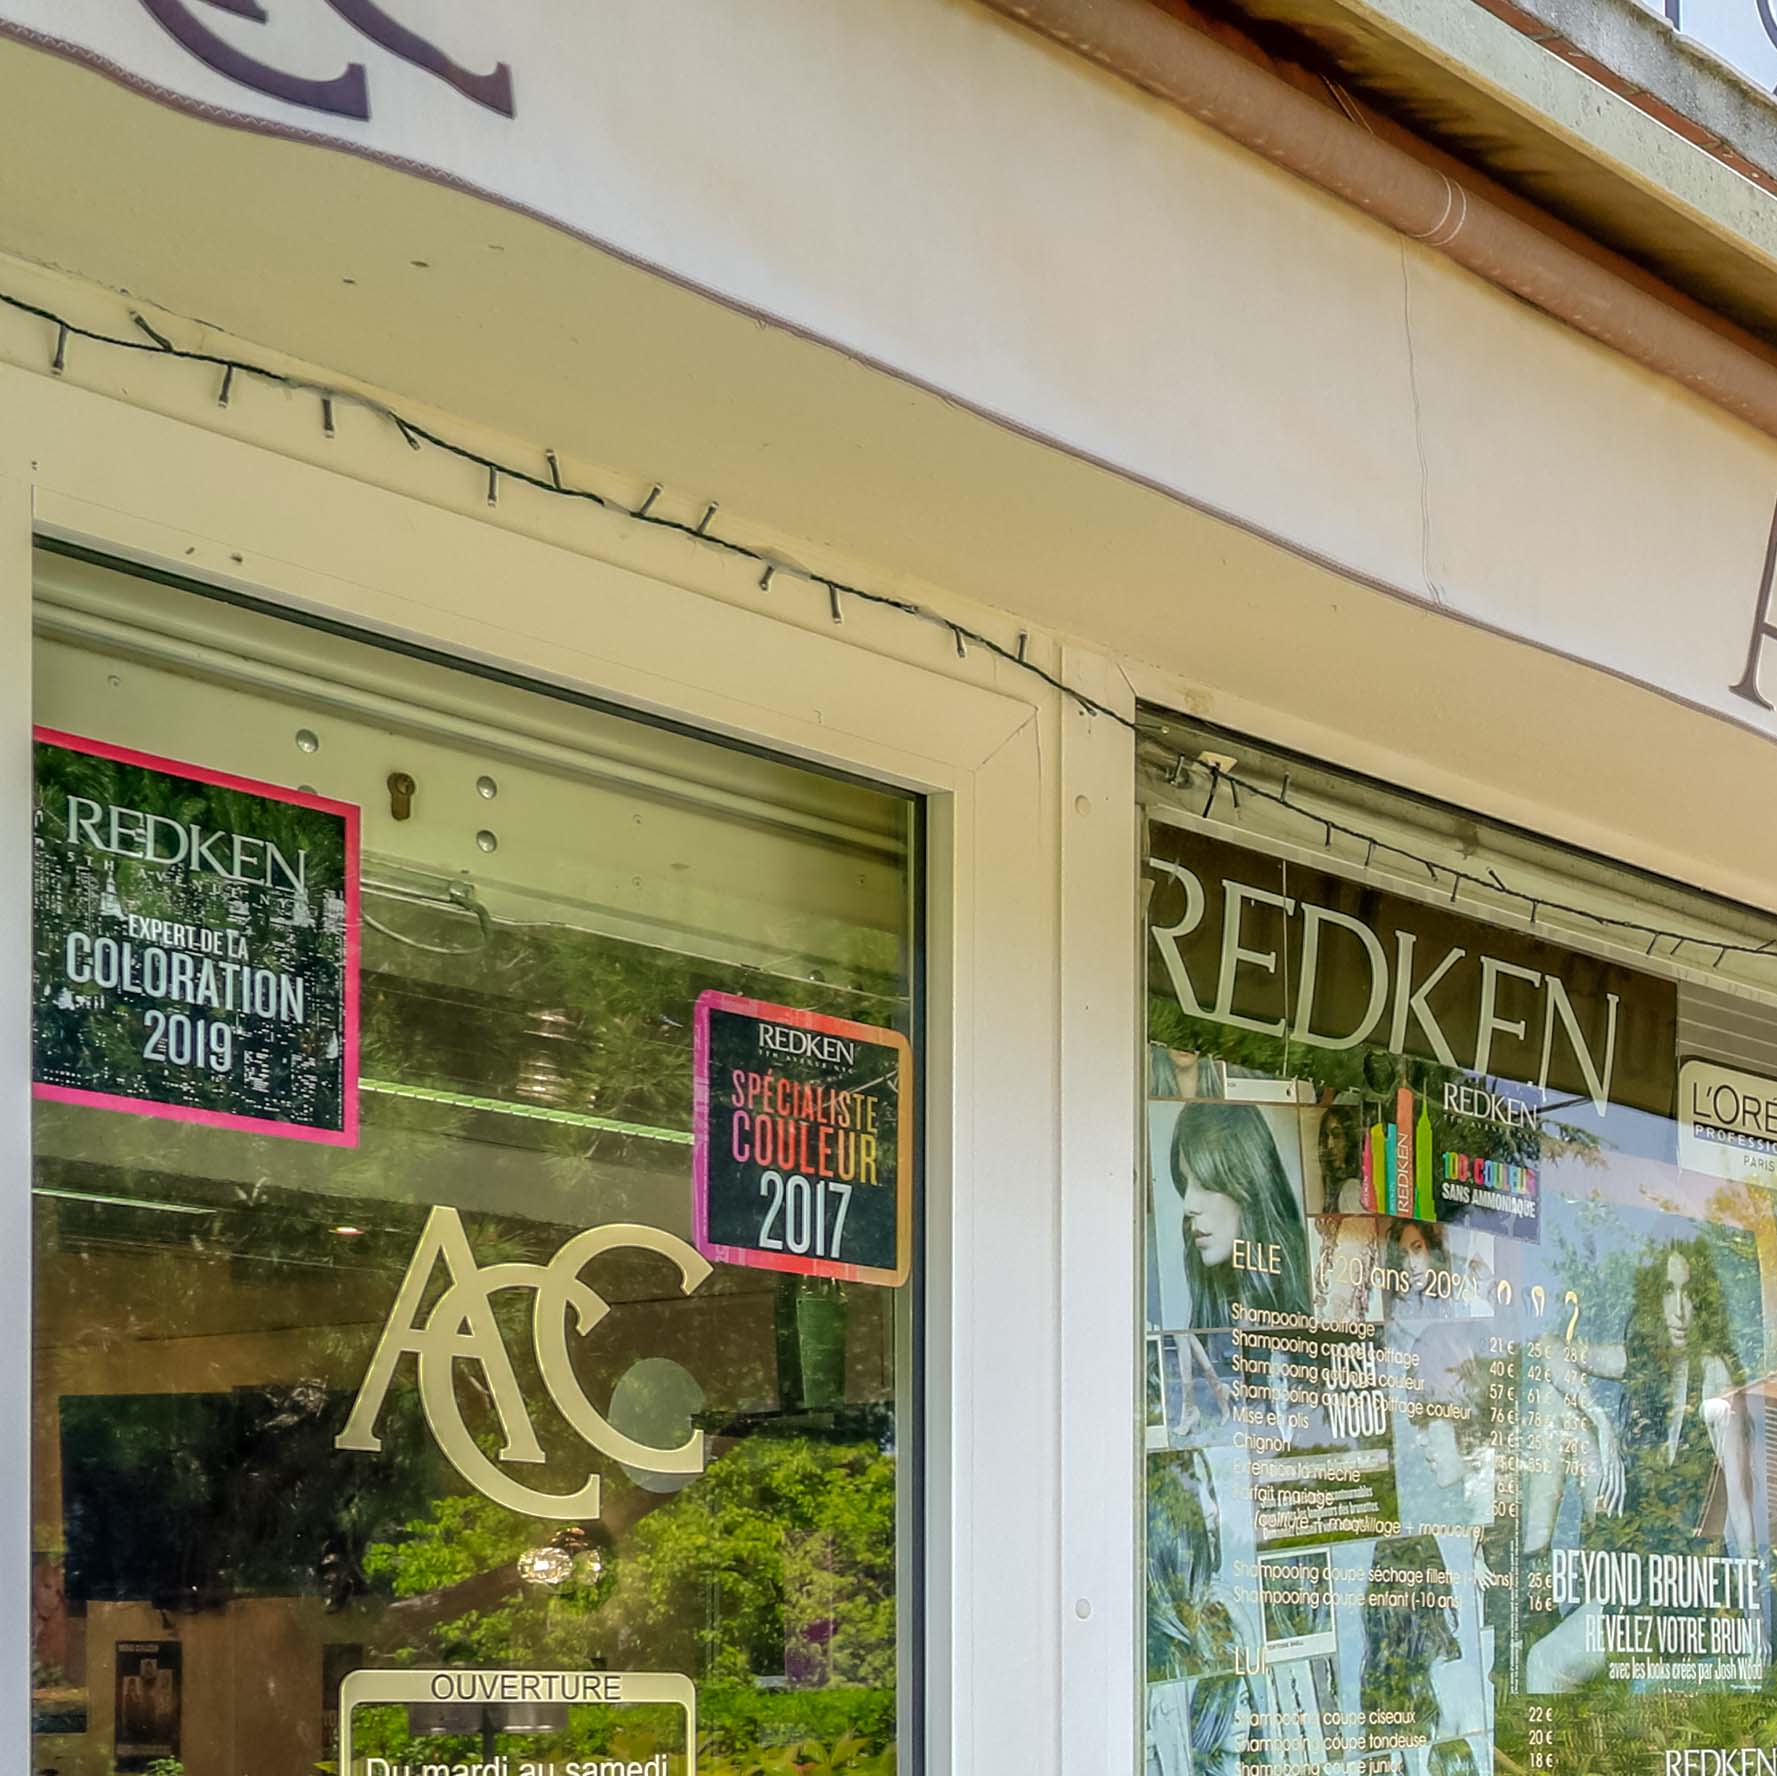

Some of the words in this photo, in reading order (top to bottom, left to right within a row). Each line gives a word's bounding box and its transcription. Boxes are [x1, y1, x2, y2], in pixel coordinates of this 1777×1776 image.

[67, 796, 306, 898] REDKEN
[129, 915, 194, 950] EXPERT
[200, 926, 224, 955] DE
[228, 929, 249, 960] LA
[66, 931, 304, 1024] COLORATION
[1149, 857, 1620, 1118] REDKEN
[143, 1010, 233, 1073] 2019
[758, 1023, 855, 1066] REDKEN
[732, 1068, 878, 1133] SPÉCIALISTE
[1443, 1082, 1537, 1131] REDKEN
[732, 1110, 878, 1186] COULEUR
[1398, 1133, 1409, 1213] REDKEN
[1744, 1155, 1776, 1173] PARIS
[759, 1170, 853, 1259] 2017
[1442, 1182, 1470, 1204] SANS
[1471, 1189, 1536, 1219] AMMONIAQUE
[1233, 1239, 1281, 1275] ELLE
[1371, 1266, 1410, 1293] ans
[1232, 1303, 1318, 1333] Shampooing
[1232, 1329, 1318, 1356] Shampooing
[1490, 1337, 1503, 1354] 21
[1490, 1361, 1504, 1377] 40
[1490, 1384, 1503, 1400] 57
[1328, 1390, 1387, 1440] WOOD
[1427, 1402, 1472, 1420] couleur
[1233, 1432, 1291, 1453] Chignon
[1369, 1566, 1423, 1587] séchage
[1552, 1549, 1642, 1607] BEYOND
[1369, 1591, 1409, 1608] enfant
[1657, 1616, 1707, 1654] VOTRE
[1711, 1616, 1752, 1655] BRUN
[1234, 1647, 1268, 1675] LUI
[1609, 1662, 1630, 1680] avec
[1632, 1656, 1646, 1680] les
[1647, 1657, 1670, 1680] looks
[1698, 1662, 1713, 1684] par
[1714, 1658, 1736, 1680] Josh
[1738, 1658, 1763, 1680] Wood
[430, 1673, 622, 1702] OUVERTURE
[1368, 1708, 1416, 1725] ciseaux
[1529, 1708, 1544, 1724] 22
[1368, 1733, 1427, 1749] tondeuse
[1529, 1730, 1544, 1746] 20
[1529, 1752, 1544, 1768] 18
